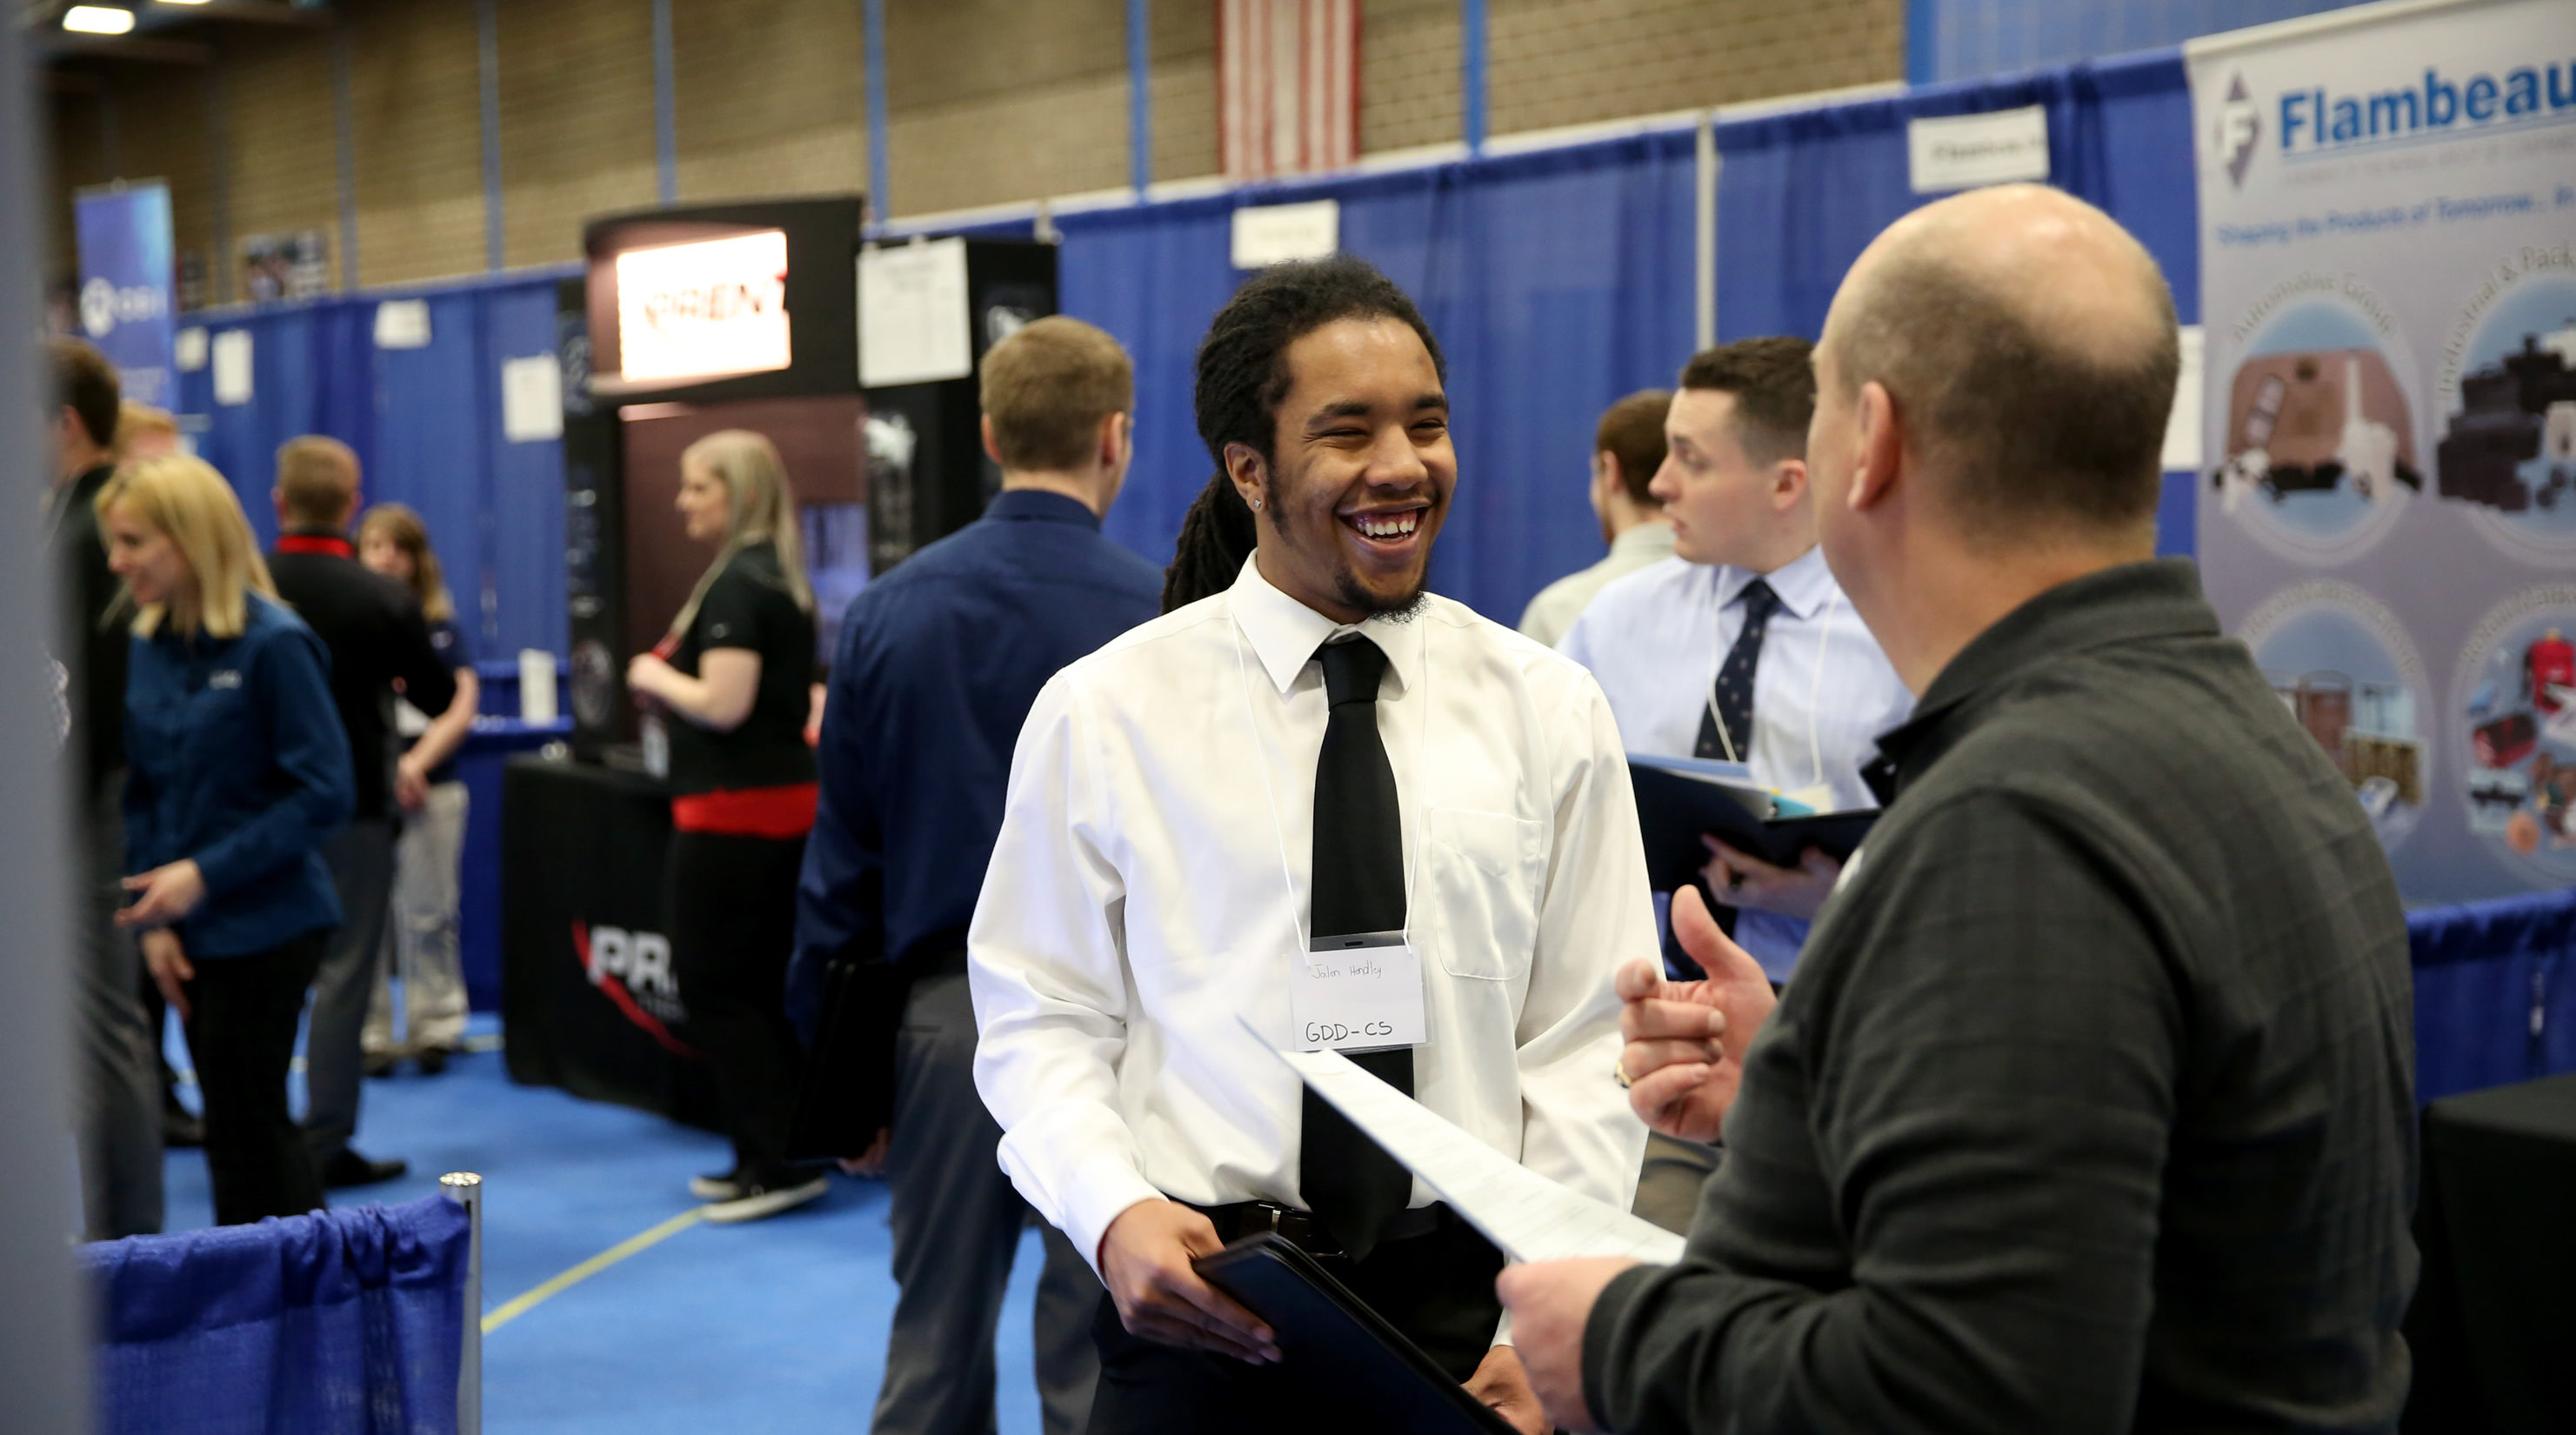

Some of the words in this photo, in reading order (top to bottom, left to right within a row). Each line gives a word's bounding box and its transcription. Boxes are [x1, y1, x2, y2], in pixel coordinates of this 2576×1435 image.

[2279, 59, 2576, 149] Flambeau
[586, 924, 675, 994] PR
[1305, 1021, 1392, 1042] GDD-CS
